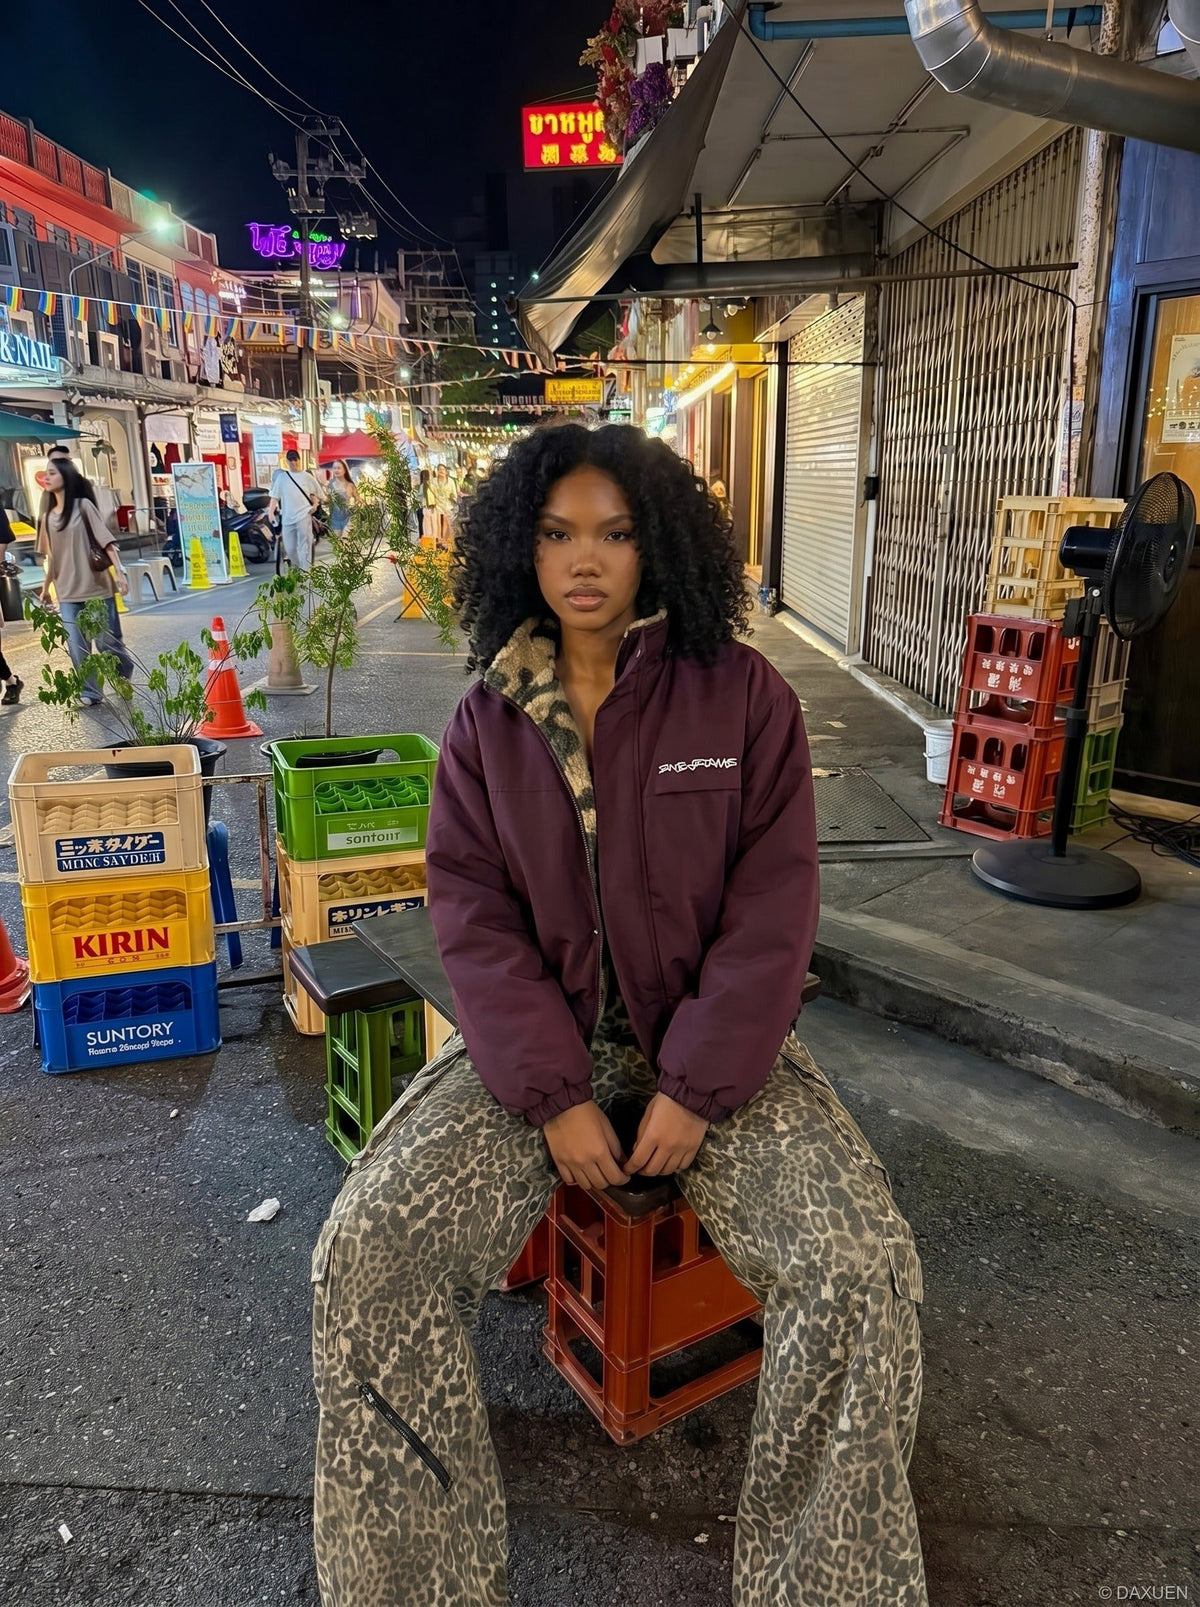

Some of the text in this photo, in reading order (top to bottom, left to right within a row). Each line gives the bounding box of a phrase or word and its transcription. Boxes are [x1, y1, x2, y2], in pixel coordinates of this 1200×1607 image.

[14, 333, 57, 372] NAIL
[73, 926, 169, 960] KIRIN
[86, 1021, 174, 1047] SUNTORY
